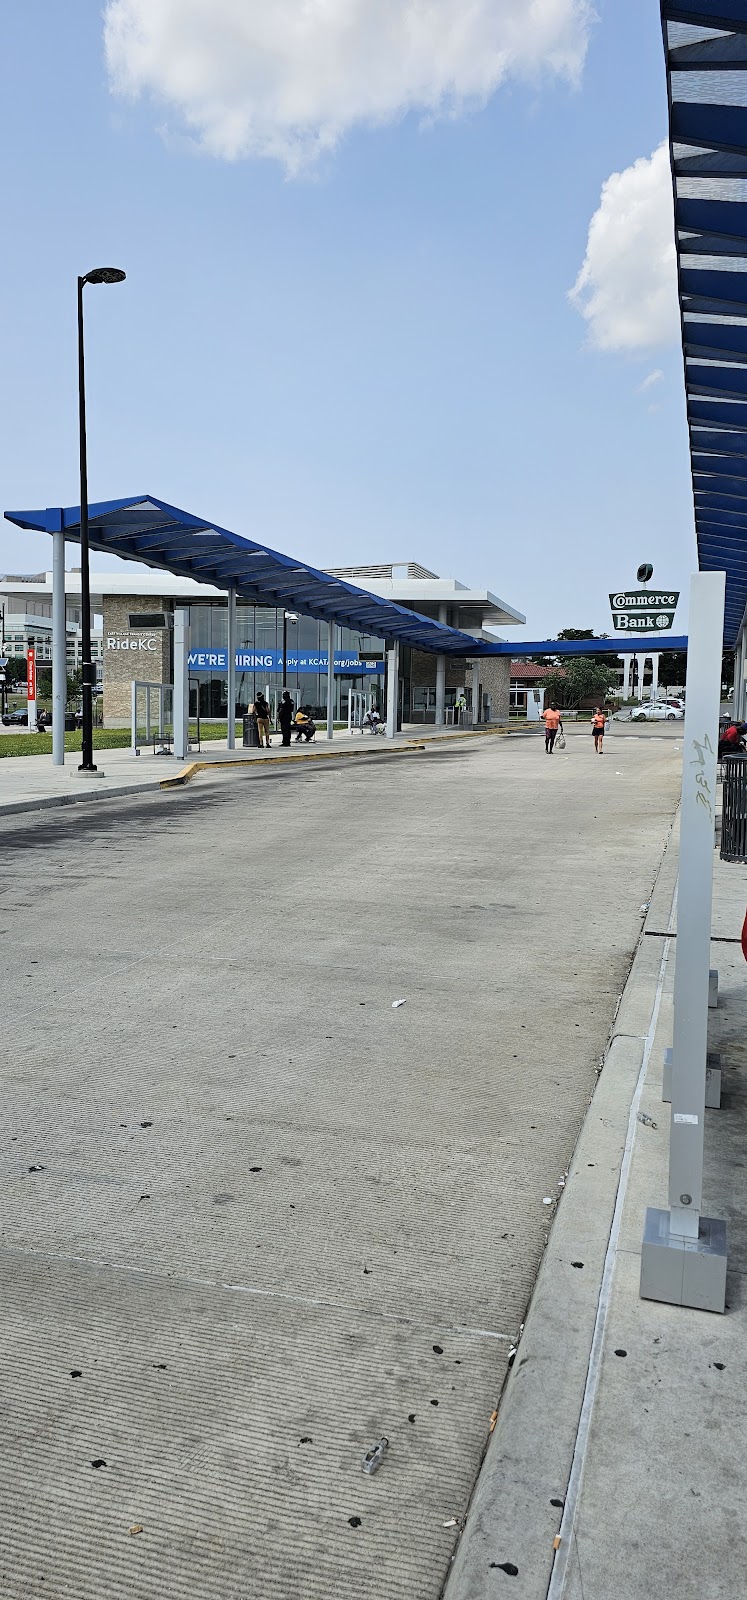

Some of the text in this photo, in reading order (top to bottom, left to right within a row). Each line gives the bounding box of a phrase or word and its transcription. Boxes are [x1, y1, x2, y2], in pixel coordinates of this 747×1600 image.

[613, 593, 675, 608] Commerce
[616, 614, 655, 629] Bank
[107, 637, 157, 651] RideKC
[277, 657, 299, 667] Aply
[308, 658, 362, 668] KCATorg/jobs
